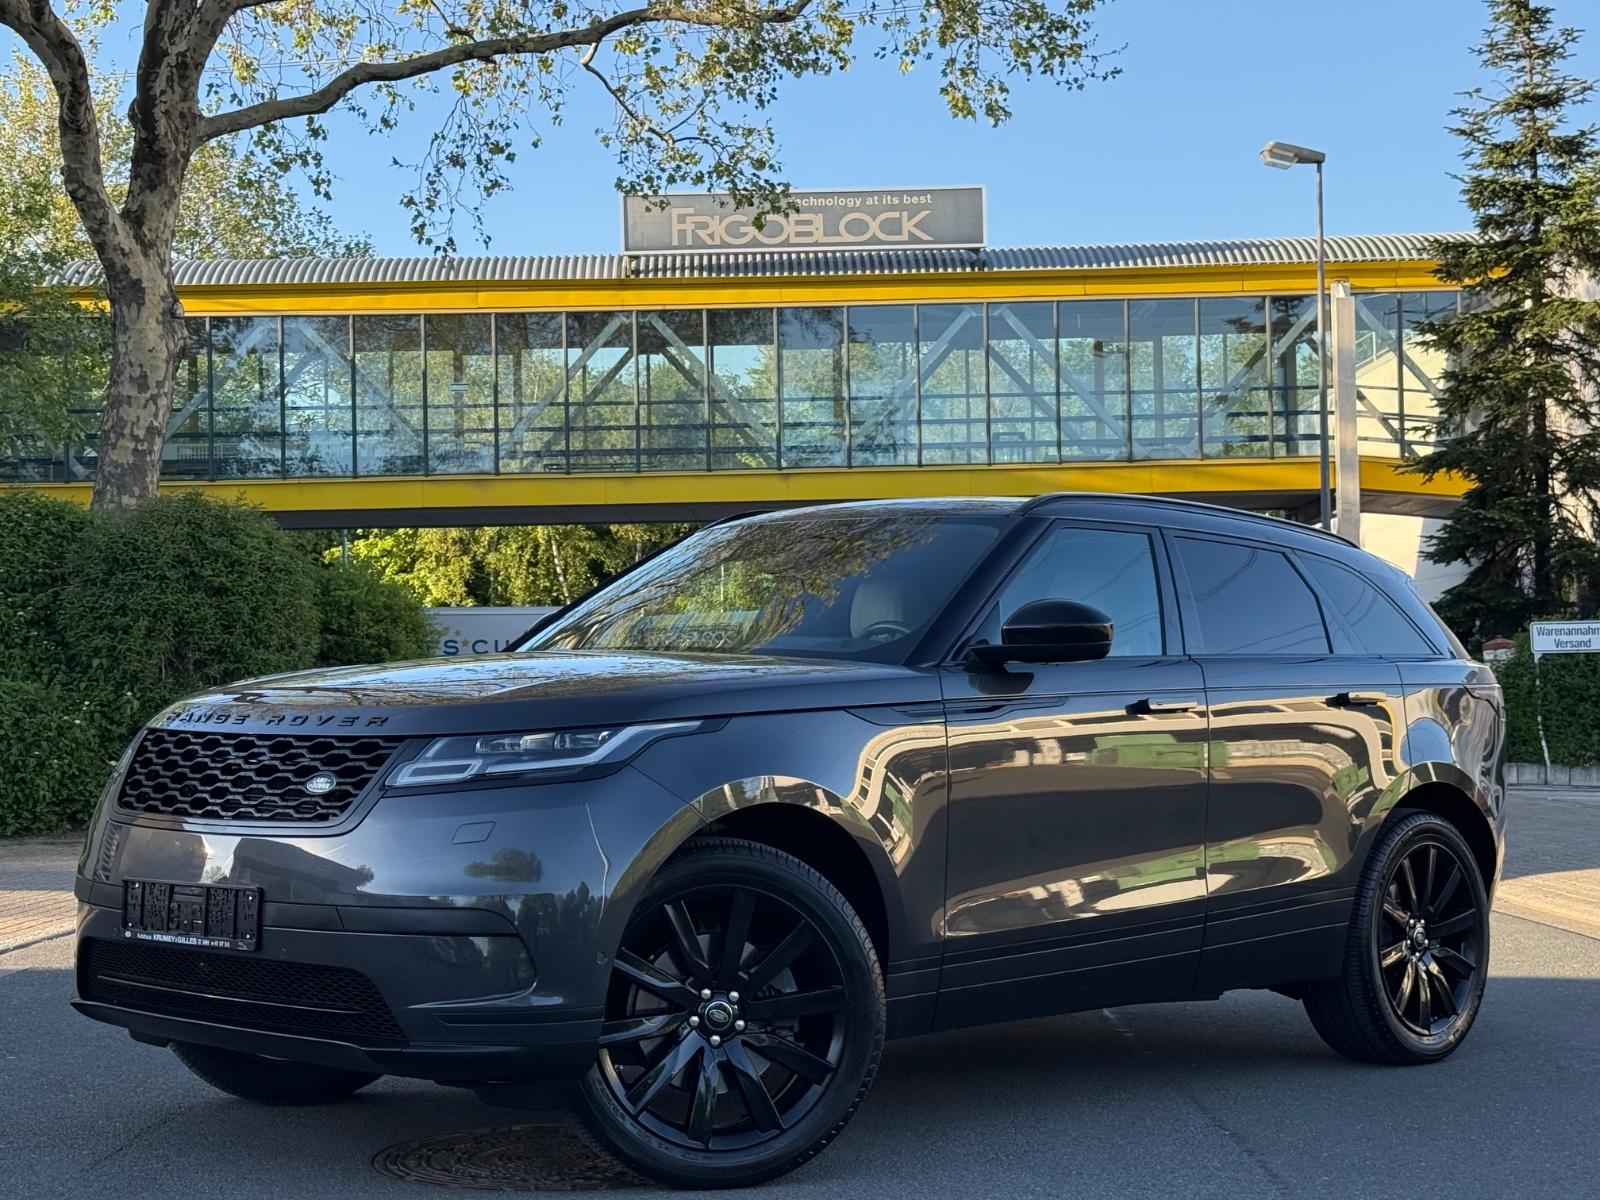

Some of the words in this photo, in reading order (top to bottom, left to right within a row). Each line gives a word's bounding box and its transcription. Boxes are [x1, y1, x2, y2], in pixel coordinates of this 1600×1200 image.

[866, 195, 879, 205] at
[882, 194, 899, 205] its
[903, 194, 932, 204] best
[671, 207, 934, 247] FRIGOBLOCK
[1554, 638, 1592, 649] Versand
[166, 711, 251, 725] RANGE
[265, 714, 389, 727] ROVER
